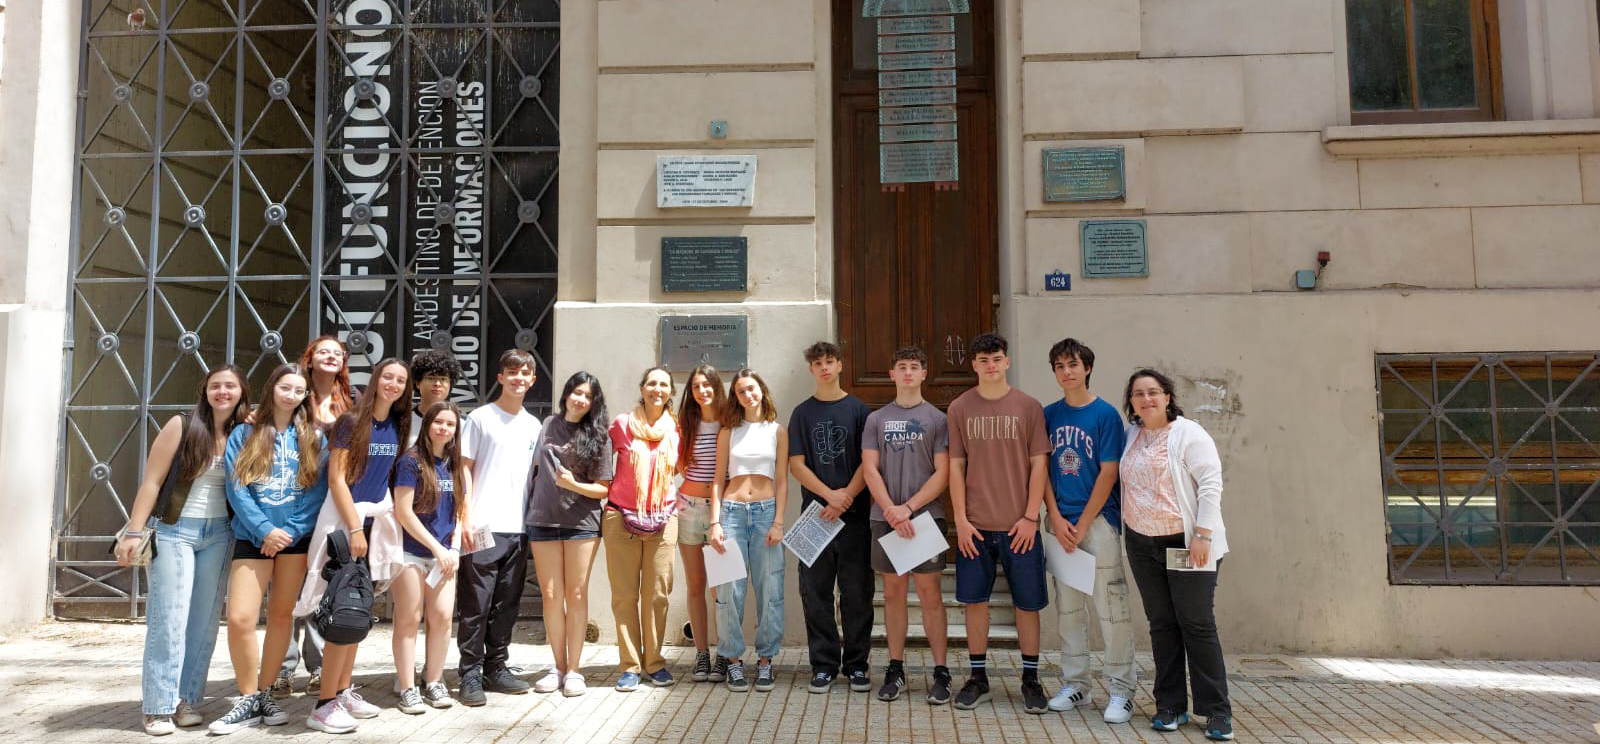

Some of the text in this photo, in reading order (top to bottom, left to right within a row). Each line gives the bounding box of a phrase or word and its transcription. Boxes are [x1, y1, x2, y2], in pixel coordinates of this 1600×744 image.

[452, 81, 484, 286] INFORMACONES
[1050, 276, 1066, 288] 624
[452, 294, 480, 326] DE
[884, 421, 907, 431] HIGH
[967, 415, 1019, 440] COUTURE
[884, 432, 923, 442] CANADA
